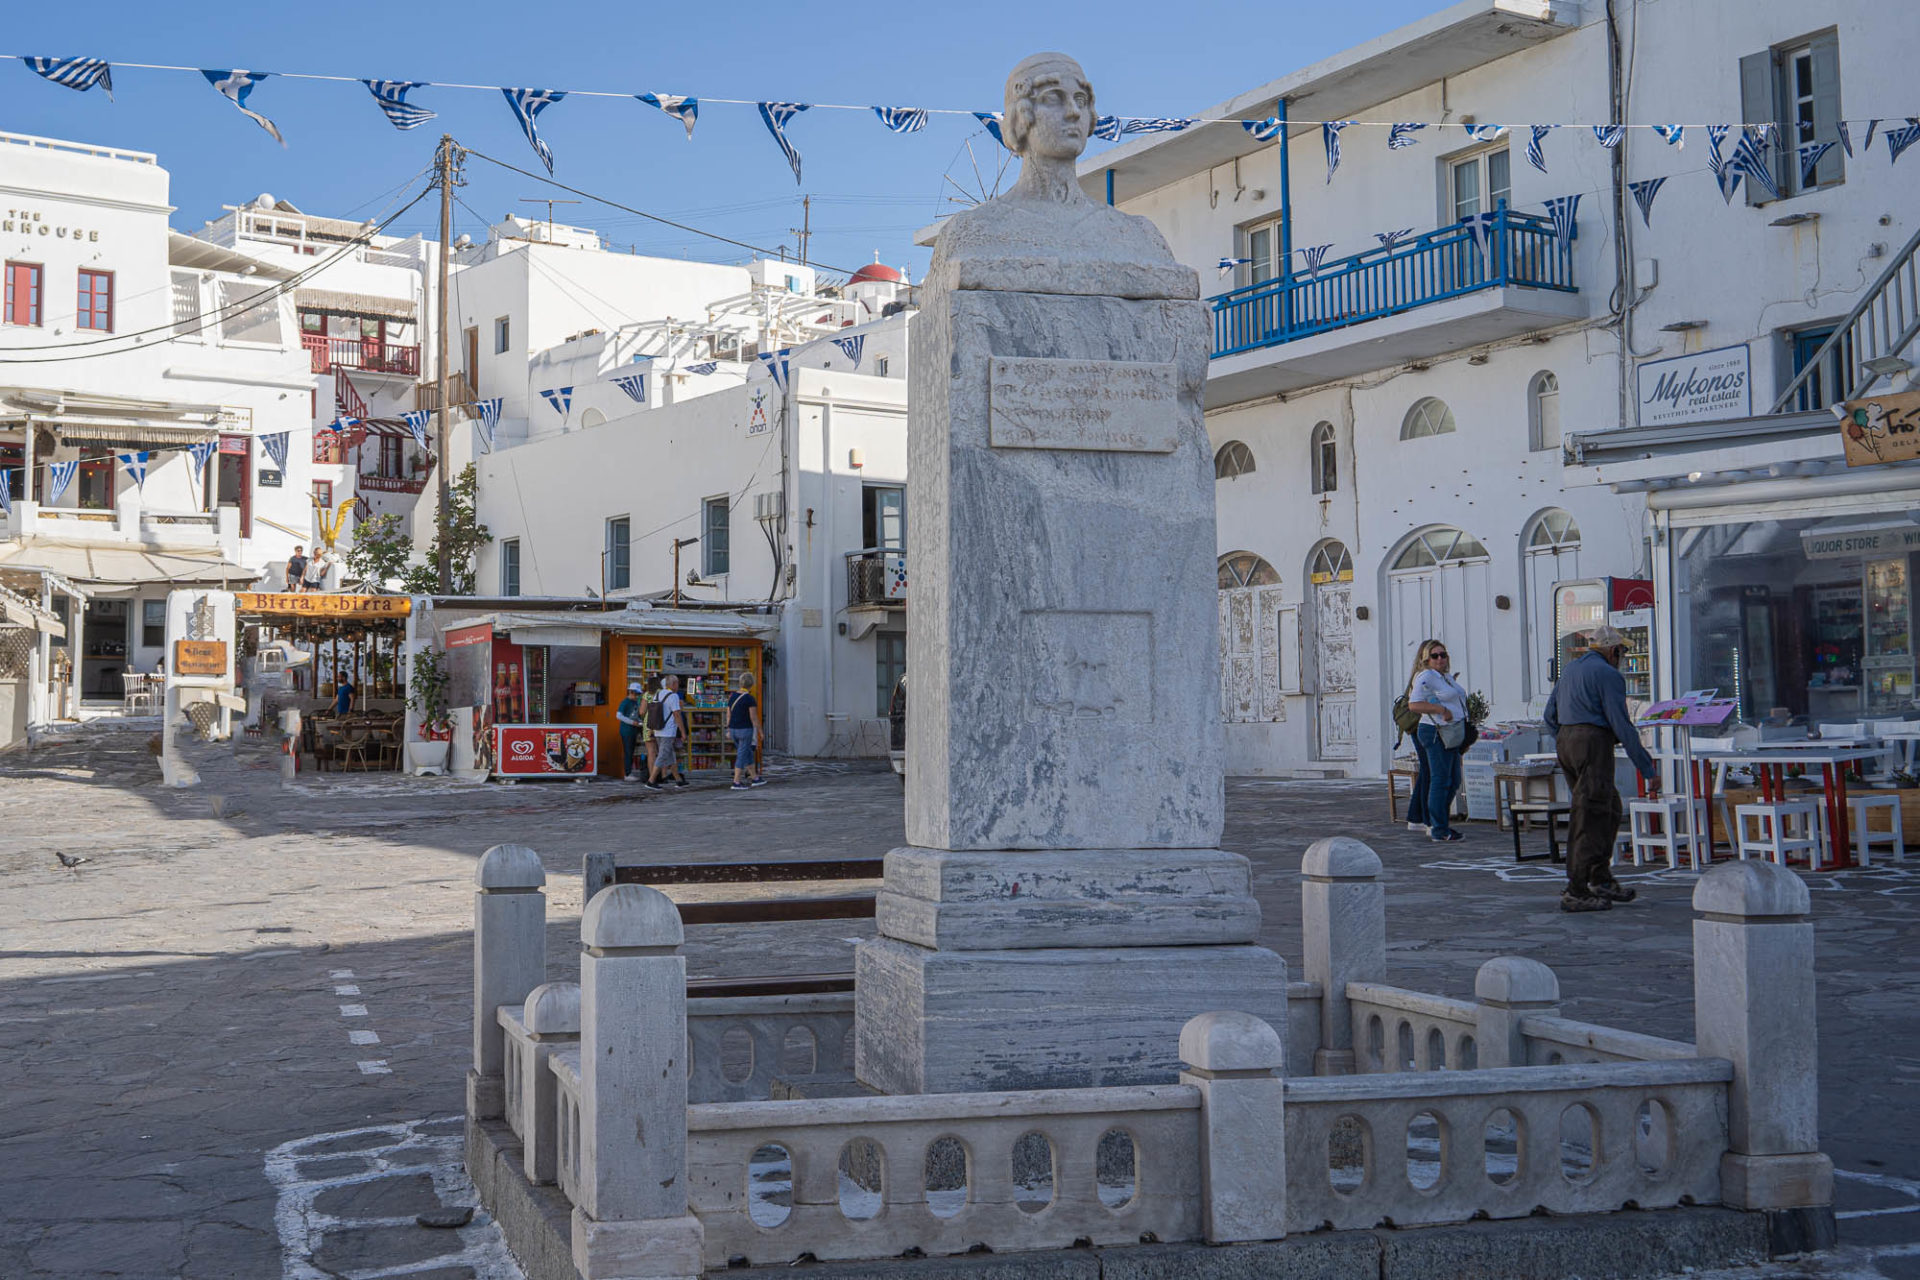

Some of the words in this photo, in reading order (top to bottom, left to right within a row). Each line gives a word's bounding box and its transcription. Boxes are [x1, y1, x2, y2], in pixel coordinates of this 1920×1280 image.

[8, 209, 40, 221] THE
[1643, 366, 1746, 408] Mykonos
[1689, 394, 1709, 406] real
[1711, 389, 1741, 403] estate
[1699, 401, 1739, 413] PARTNERS
[1876, 407, 1915, 436] Trio
[1845, 536, 1880, 551] STORE
